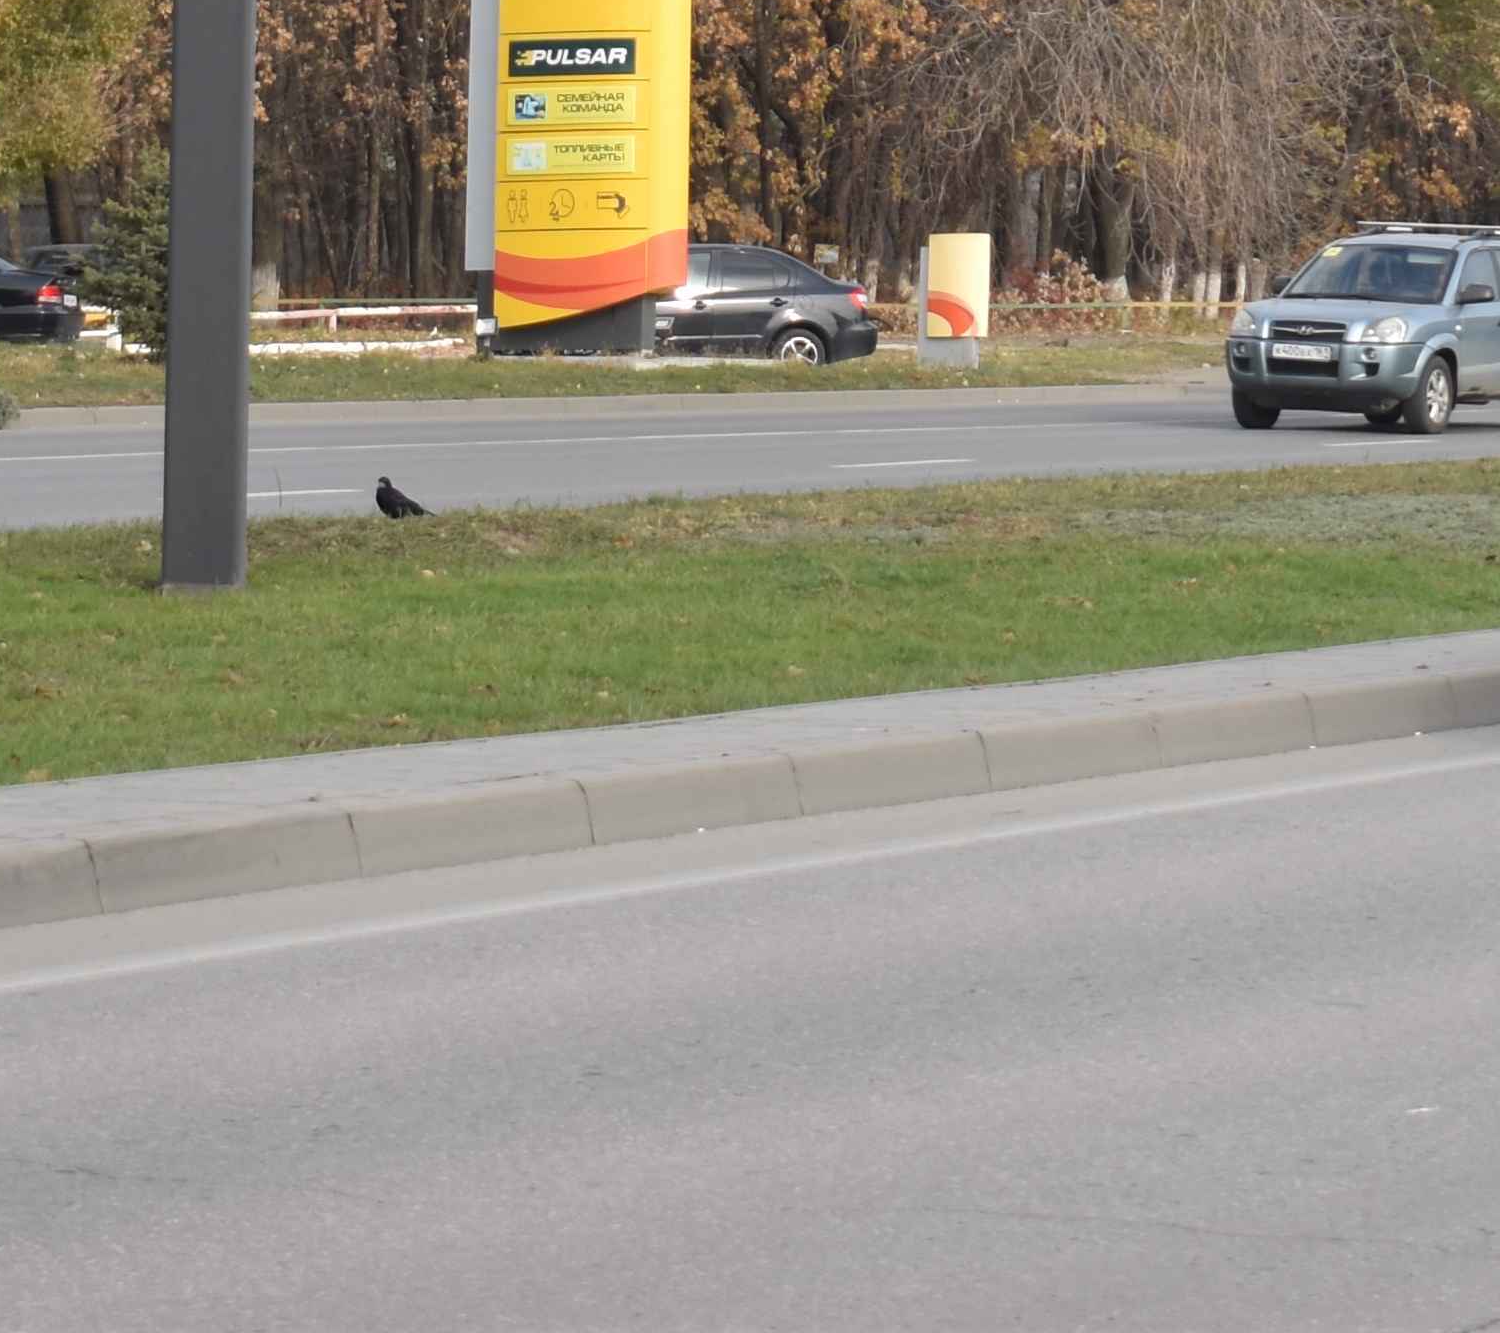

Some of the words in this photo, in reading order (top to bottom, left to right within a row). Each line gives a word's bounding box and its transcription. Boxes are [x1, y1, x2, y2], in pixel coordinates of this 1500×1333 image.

[530, 46, 628, 66] PULSAR
[556, 91, 625, 104] СЕМЕЙНАЯ
[562, 103, 625, 114] КОМАНДА
[554, 143, 625, 154] ТОПЛИВНЫЕ
[582, 153, 625, 163] КАРТЫ
